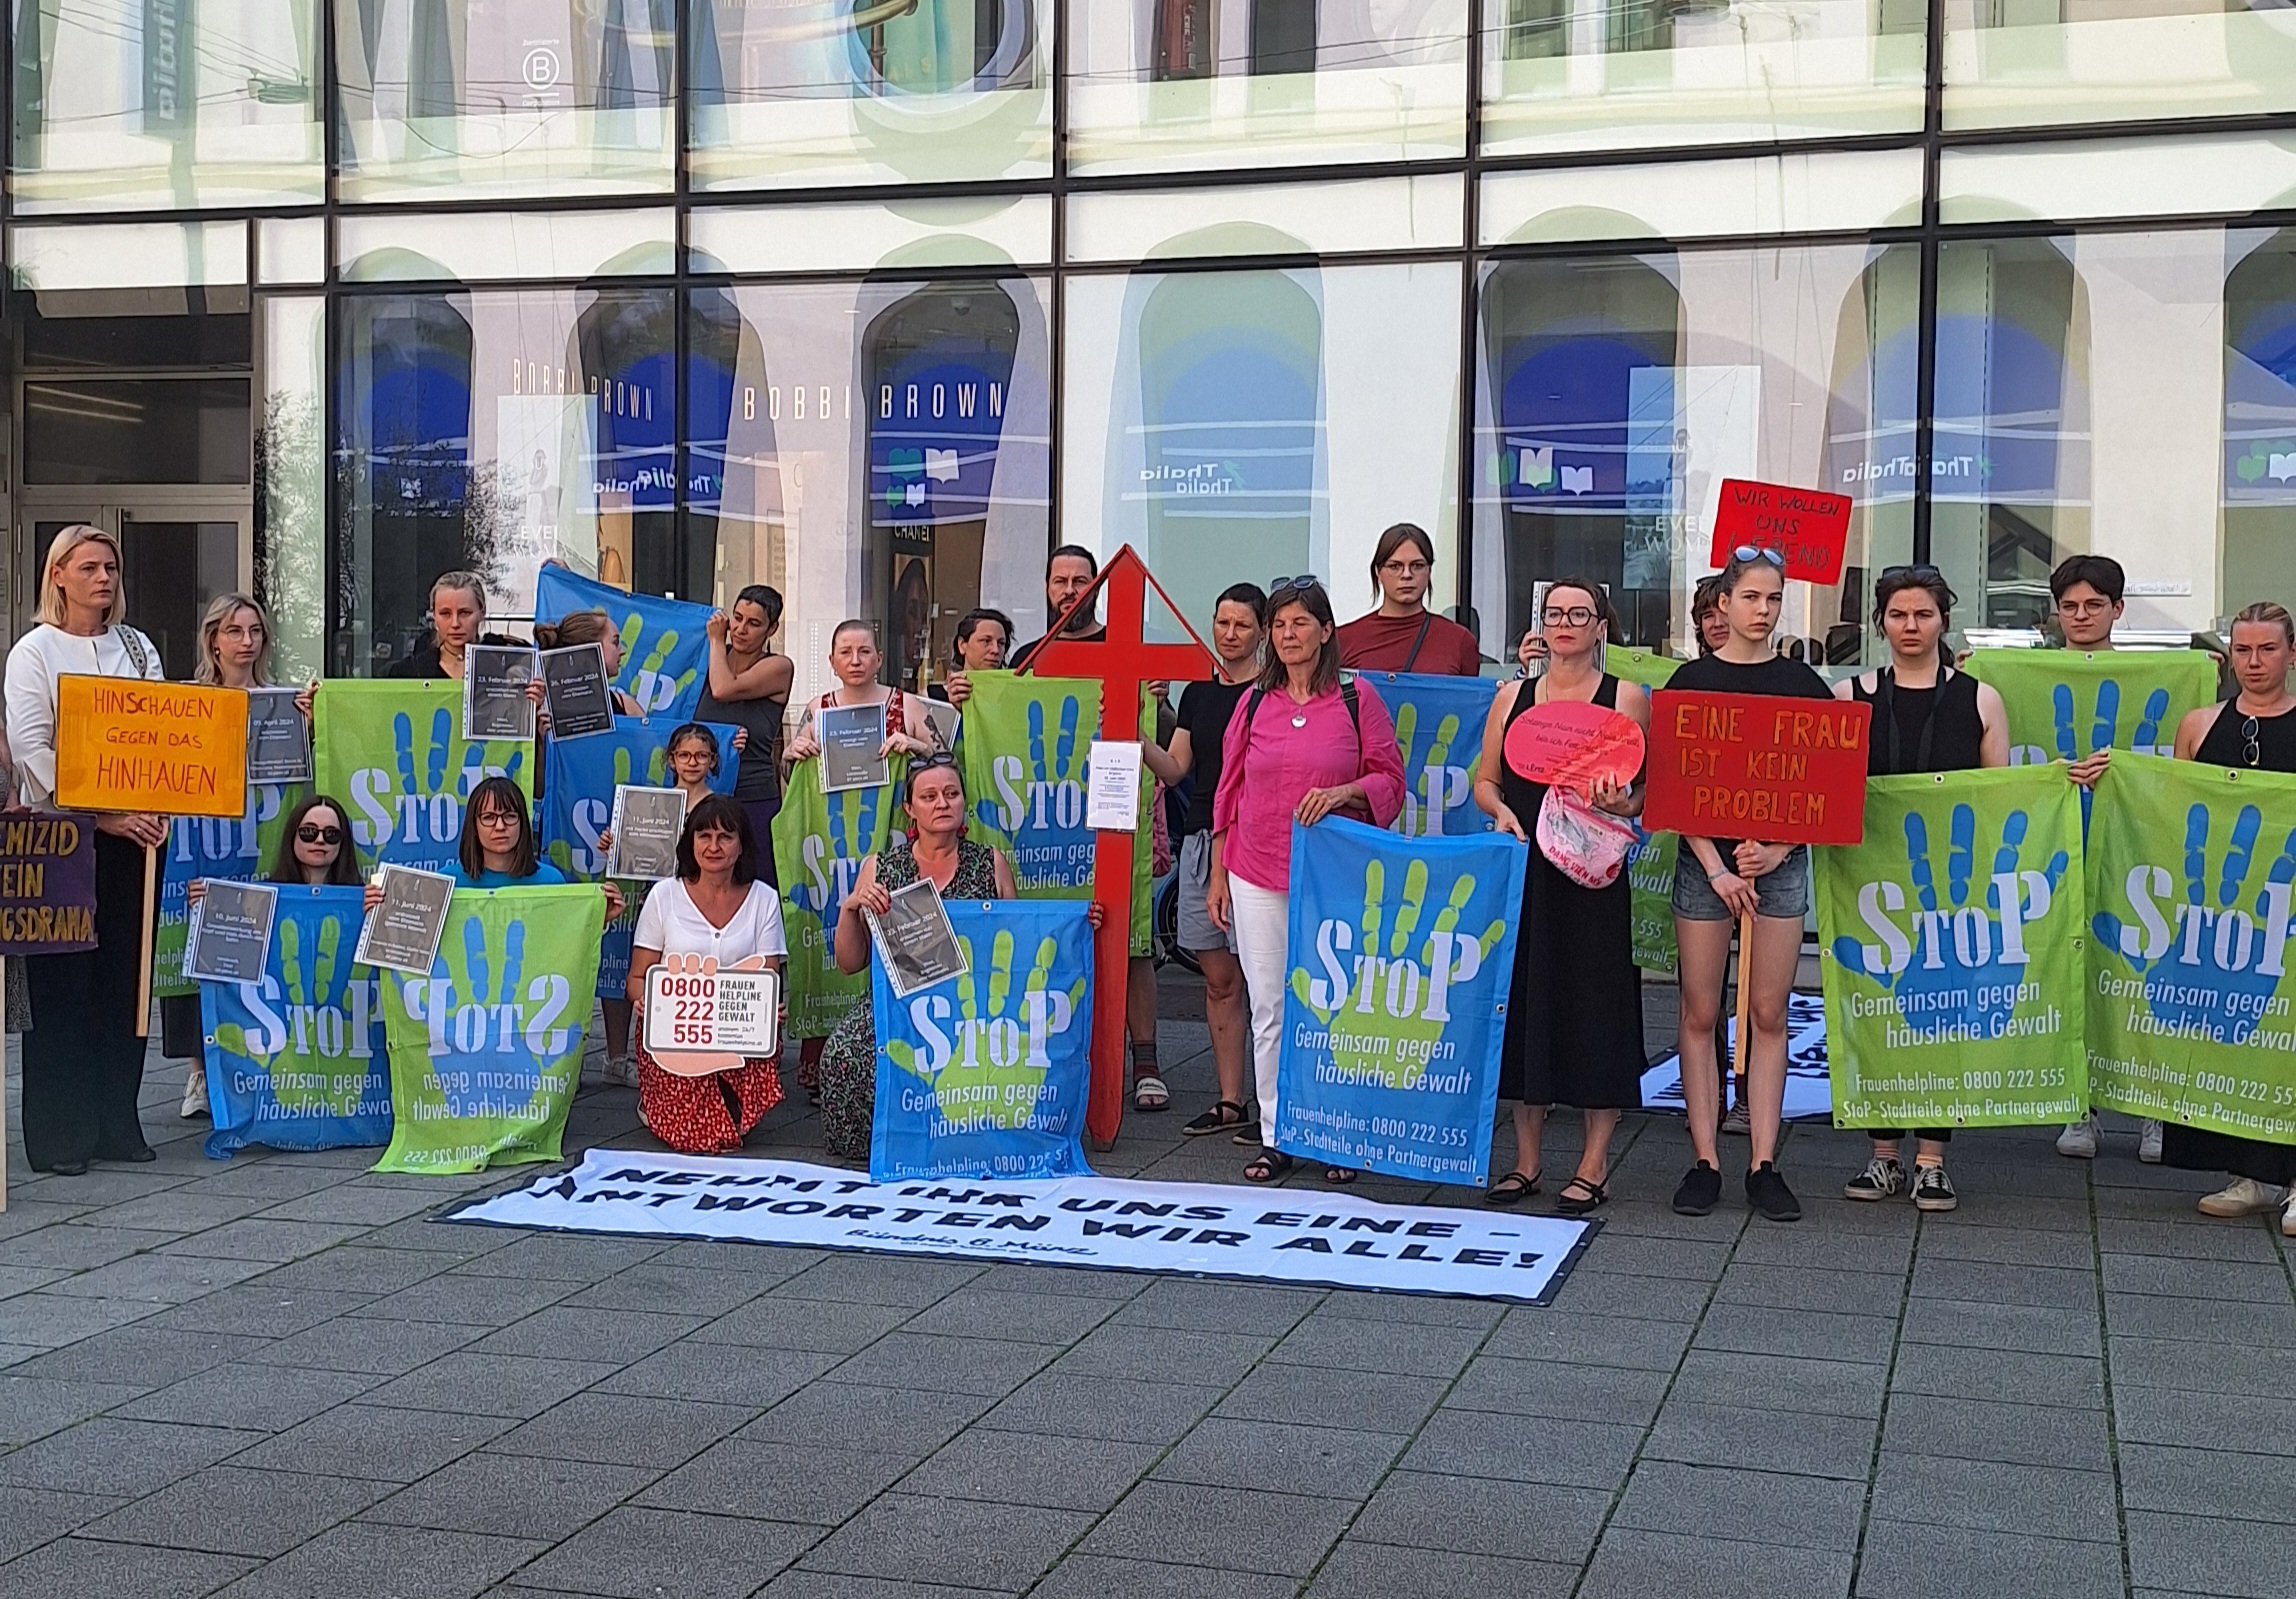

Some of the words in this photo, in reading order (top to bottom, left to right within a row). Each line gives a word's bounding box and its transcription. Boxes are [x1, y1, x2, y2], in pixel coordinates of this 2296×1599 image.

[743, 385, 850, 420] BOBBI
[880, 382, 1002, 419] BROWN
[1734, 485, 1770, 509] WIR
[1778, 492, 1840, 517] WOLLEN
[1755, 516, 1800, 536] UNS
[94, 686, 214, 720] HINSCHAUEN
[106, 727, 159, 747] GEGEN
[168, 732, 203, 749] DAS
[1675, 700, 1745, 743] EINE
[1773, 710, 1864, 750] FRAU
[96, 752, 217, 796] HINHAUEN
[1680, 742, 1723, 778] IST
[1746, 747, 1809, 782] KEIN
[1692, 785, 1826, 827] PROBLEM
[0, 859, 44, 898] EIN
[661, 976, 715, 997] 0800
[719, 990, 763, 1001] HELPLINE
[720, 979, 756, 990] FRAUEN
[1851, 987, 1969, 1018] Gemeinsam
[1977, 981, 2040, 1012] gegen
[2098, 969, 2219, 1009] Gemeinsam
[2225, 990, 2290, 1020] gegen
[674, 1000, 714, 1021] 222
[718, 1011, 756, 1022] GEWALT
[719, 1001, 748, 1011] GEGEN
[673, 1023, 713, 1045] 555
[1885, 1017, 1982, 1049] häusliche
[1990, 1004, 2062, 1039] Gewalt
[2126, 1004, 2225, 1044] häusliche
[1294, 1022, 1390, 1057] Gemeinsam
[1396, 1036, 1456, 1066] gegen
[233, 1070, 327, 1095] Gemeinsam
[333, 1071, 382, 1095] gegen
[1315, 1055, 1397, 1088] häusliche
[1402, 1065, 1473, 1095] Gewalt
[1855, 1071, 1960, 1099] Frauenhelpline:
[1963, 1071, 2001, 1090] 0800
[2006, 1069, 2034, 1089] 222
[2039, 1067, 2065, 1087] 555
[2087, 1048, 2193, 1088] Frauenhelpline:
[2196, 1071, 2237, 1097] 0800
[2240, 1078, 2268, 1103] 222
[257, 1095, 339, 1121] häusliche
[901, 1083, 999, 1113] Gemeinsam
[1004, 1082, 1058, 1107] gegen
[1843, 1099, 1942, 1119] StoP-Stadtteile
[1947, 1098, 1980, 1119] ohne
[1985, 1092, 2080, 1118] Partnergewalt
[2173, 1095, 2207, 1119] ohne
[929, 1113, 1007, 1140] häusliche
[1013, 1107, 1068, 1134] Gewalt
[1287, 1100, 1370, 1133] Frauenhelpline:
[1371, 1116, 1406, 1139] 0800
[1410, 1121, 1437, 1144] 222
[1440, 1126, 1468, 1148] 555
[994, 1154, 1026, 1173] 0800
[1355, 1138, 1384, 1161] ohne
[1387, 1145, 1478, 1174] Partnergewalt
[1057, 1197, 1231, 1222] UNS
[1253, 1210, 1461, 1239] EINE
[1082, 1219, 1252, 1249] WIR
[1273, 1236, 1544, 1270] ALLE!
